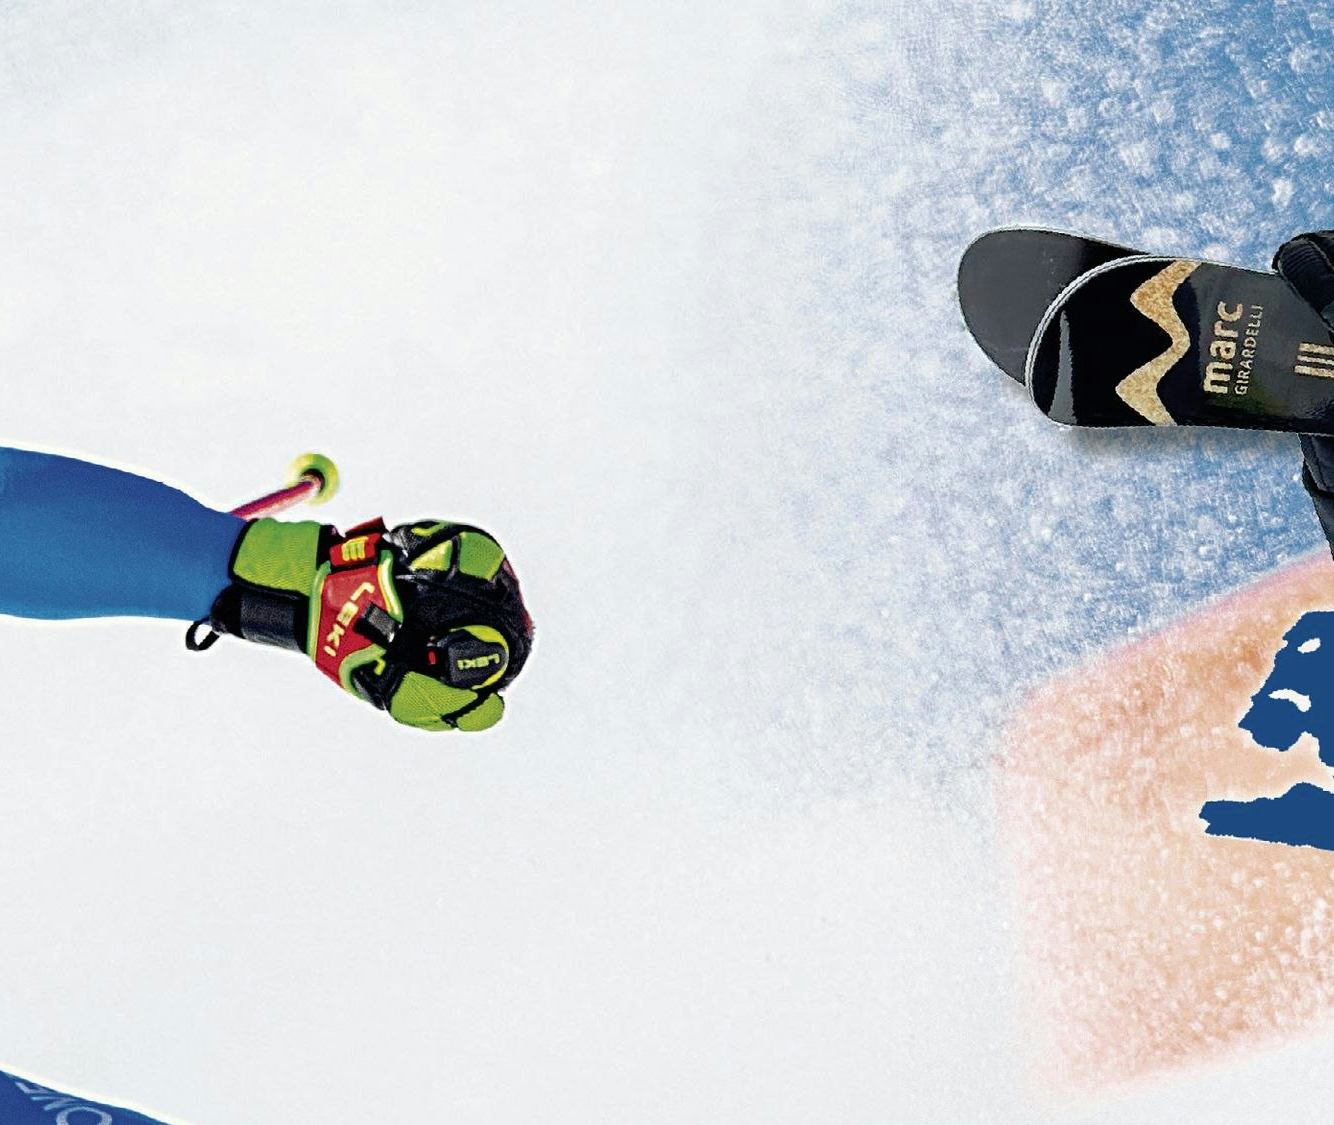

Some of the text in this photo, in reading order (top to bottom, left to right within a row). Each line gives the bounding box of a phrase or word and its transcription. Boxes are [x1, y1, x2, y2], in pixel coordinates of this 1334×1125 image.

[1203, 301, 1244, 394] marc
[1234, 304, 1264, 395] GIRARDELLI
[323, 582, 376, 658] LEKI
[457, 653, 501, 670] LEKI
